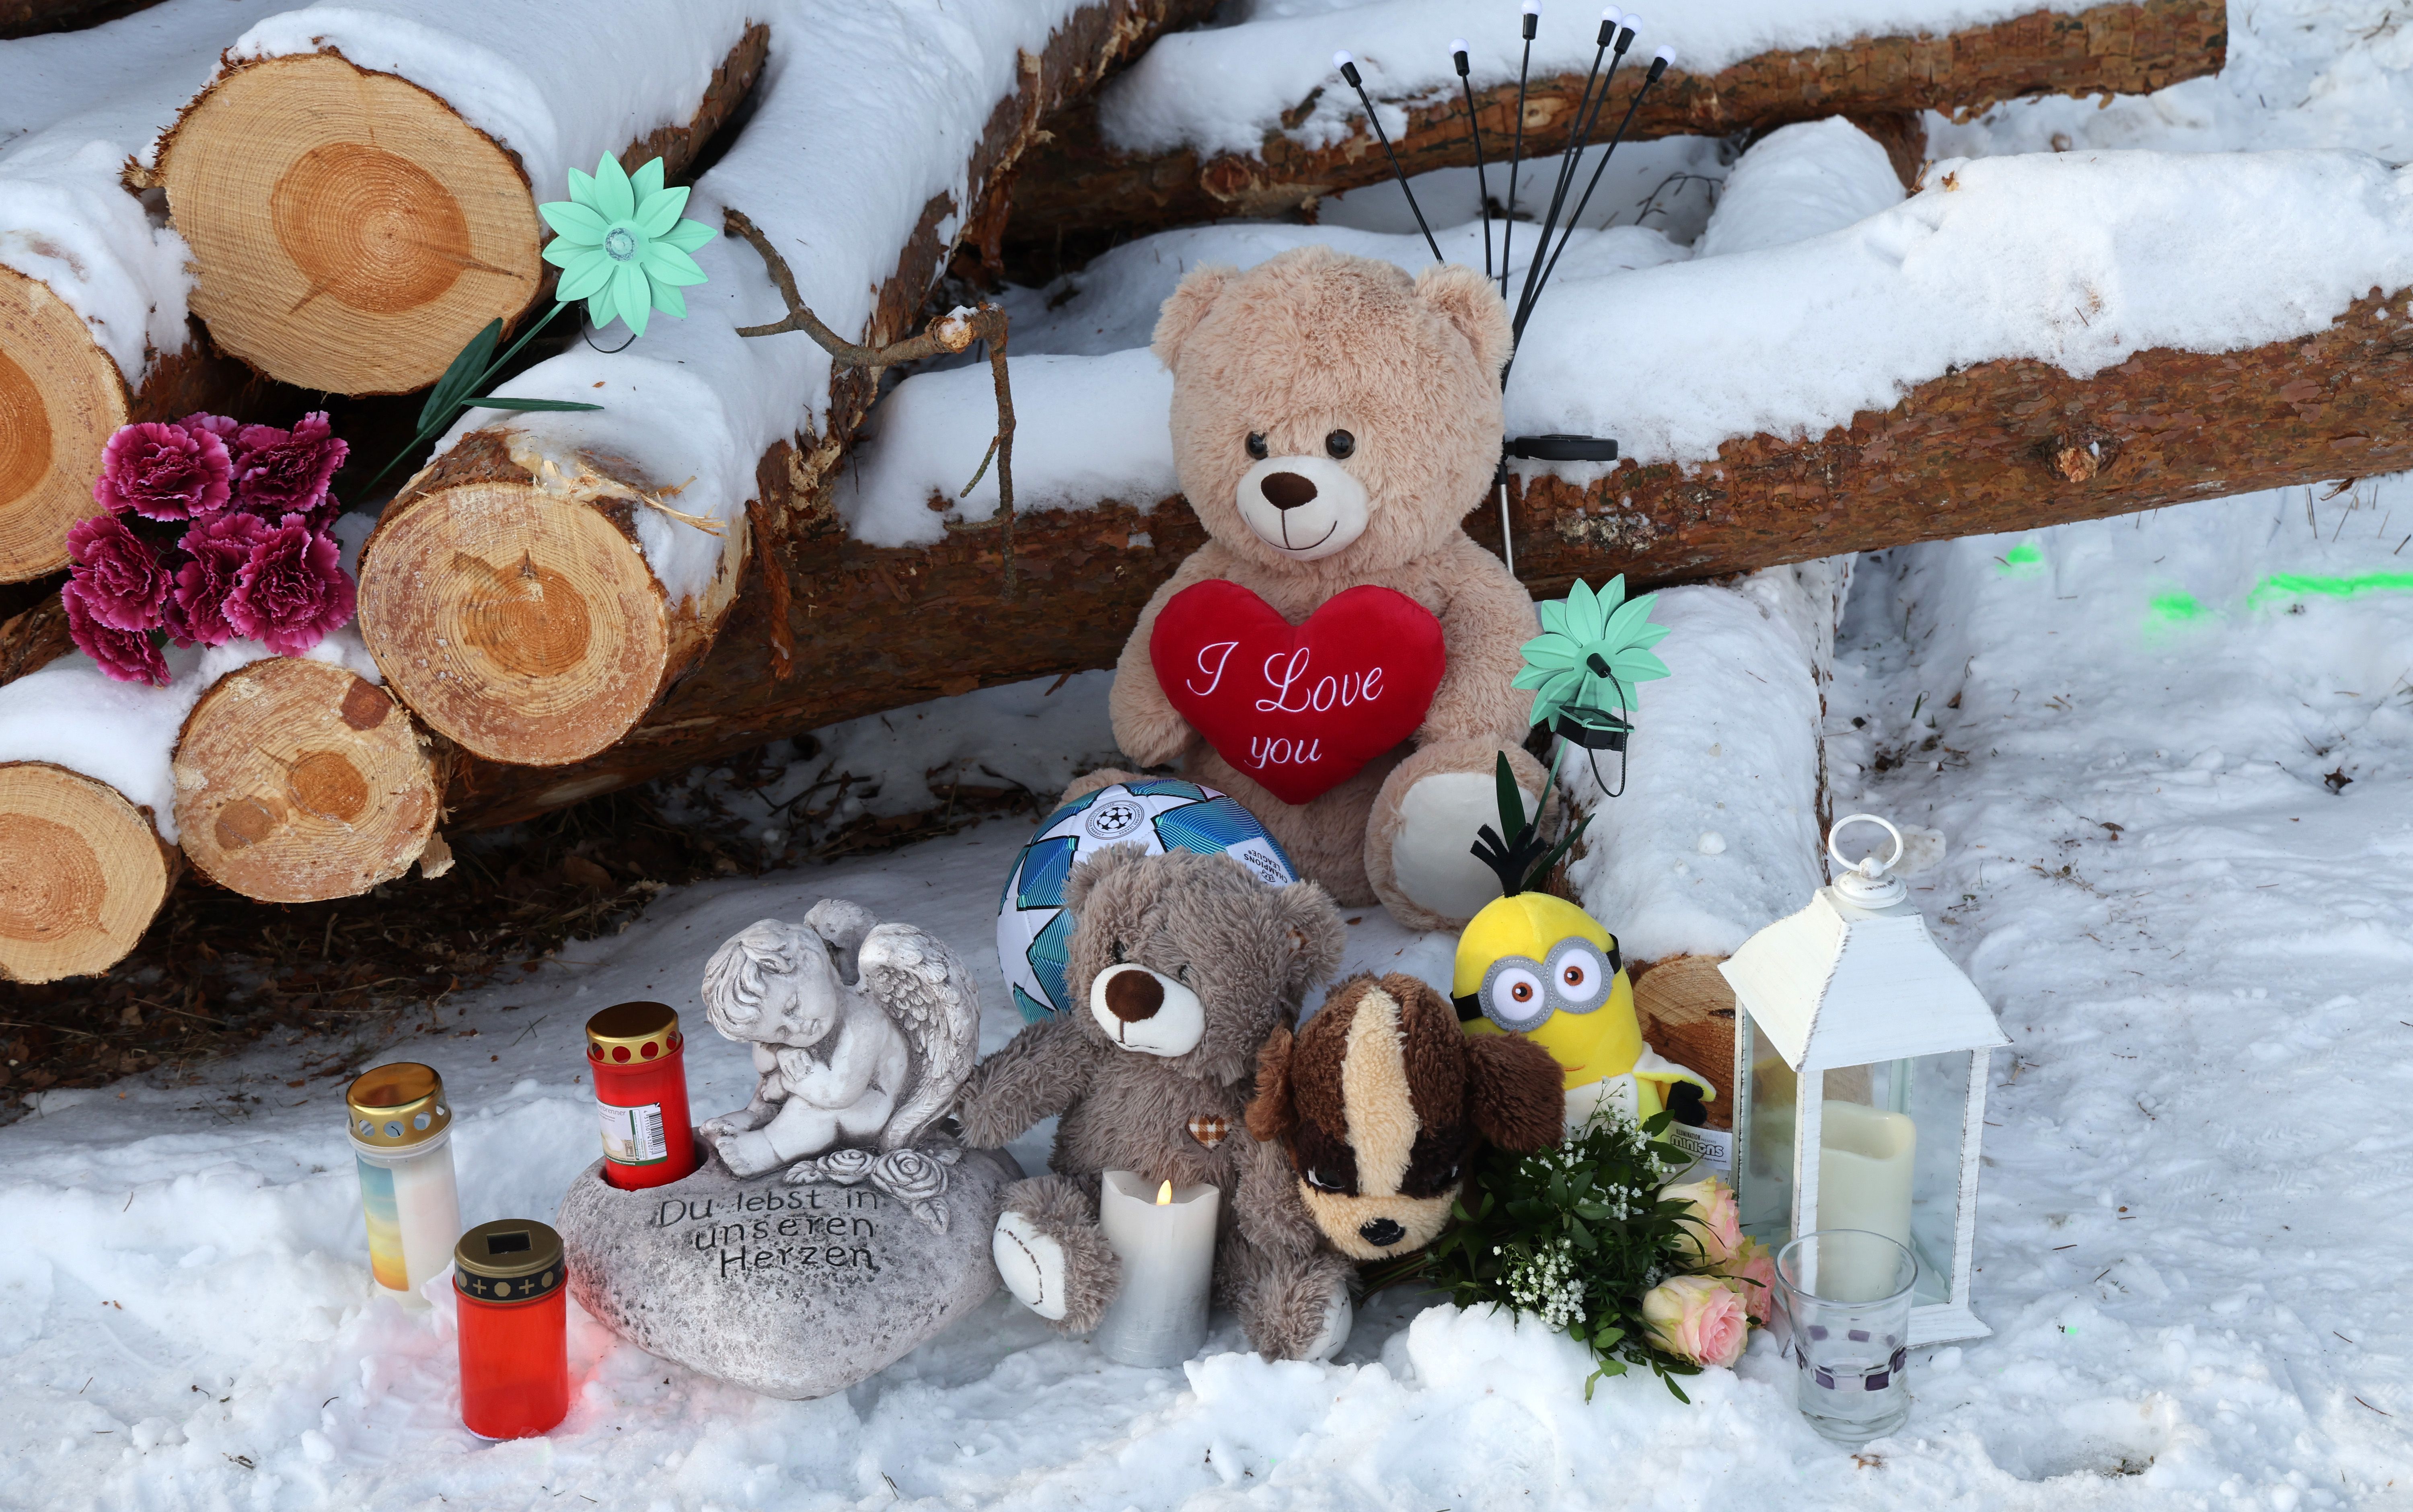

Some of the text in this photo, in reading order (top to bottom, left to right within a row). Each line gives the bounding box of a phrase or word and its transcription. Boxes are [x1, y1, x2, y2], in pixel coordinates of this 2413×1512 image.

[1187, 642, 1383, 712] I Love
[1244, 737, 1322, 769] you
[1097, 803, 1115, 812] OFFICIAL
[1090, 827, 1105, 836] PRODUCT
[1119, 826, 1134, 835] LEAGUE
[1244, 854, 1287, 883] CHAMPIONS
[1262, 870, 1275, 881] UEFA
[1676, 1129, 1701, 1140] ILLUMINATION
[660, 1188, 878, 1226] Du lebst in
[696, 1217, 873, 1251] unseren
[721, 1245, 875, 1278] Herzen
